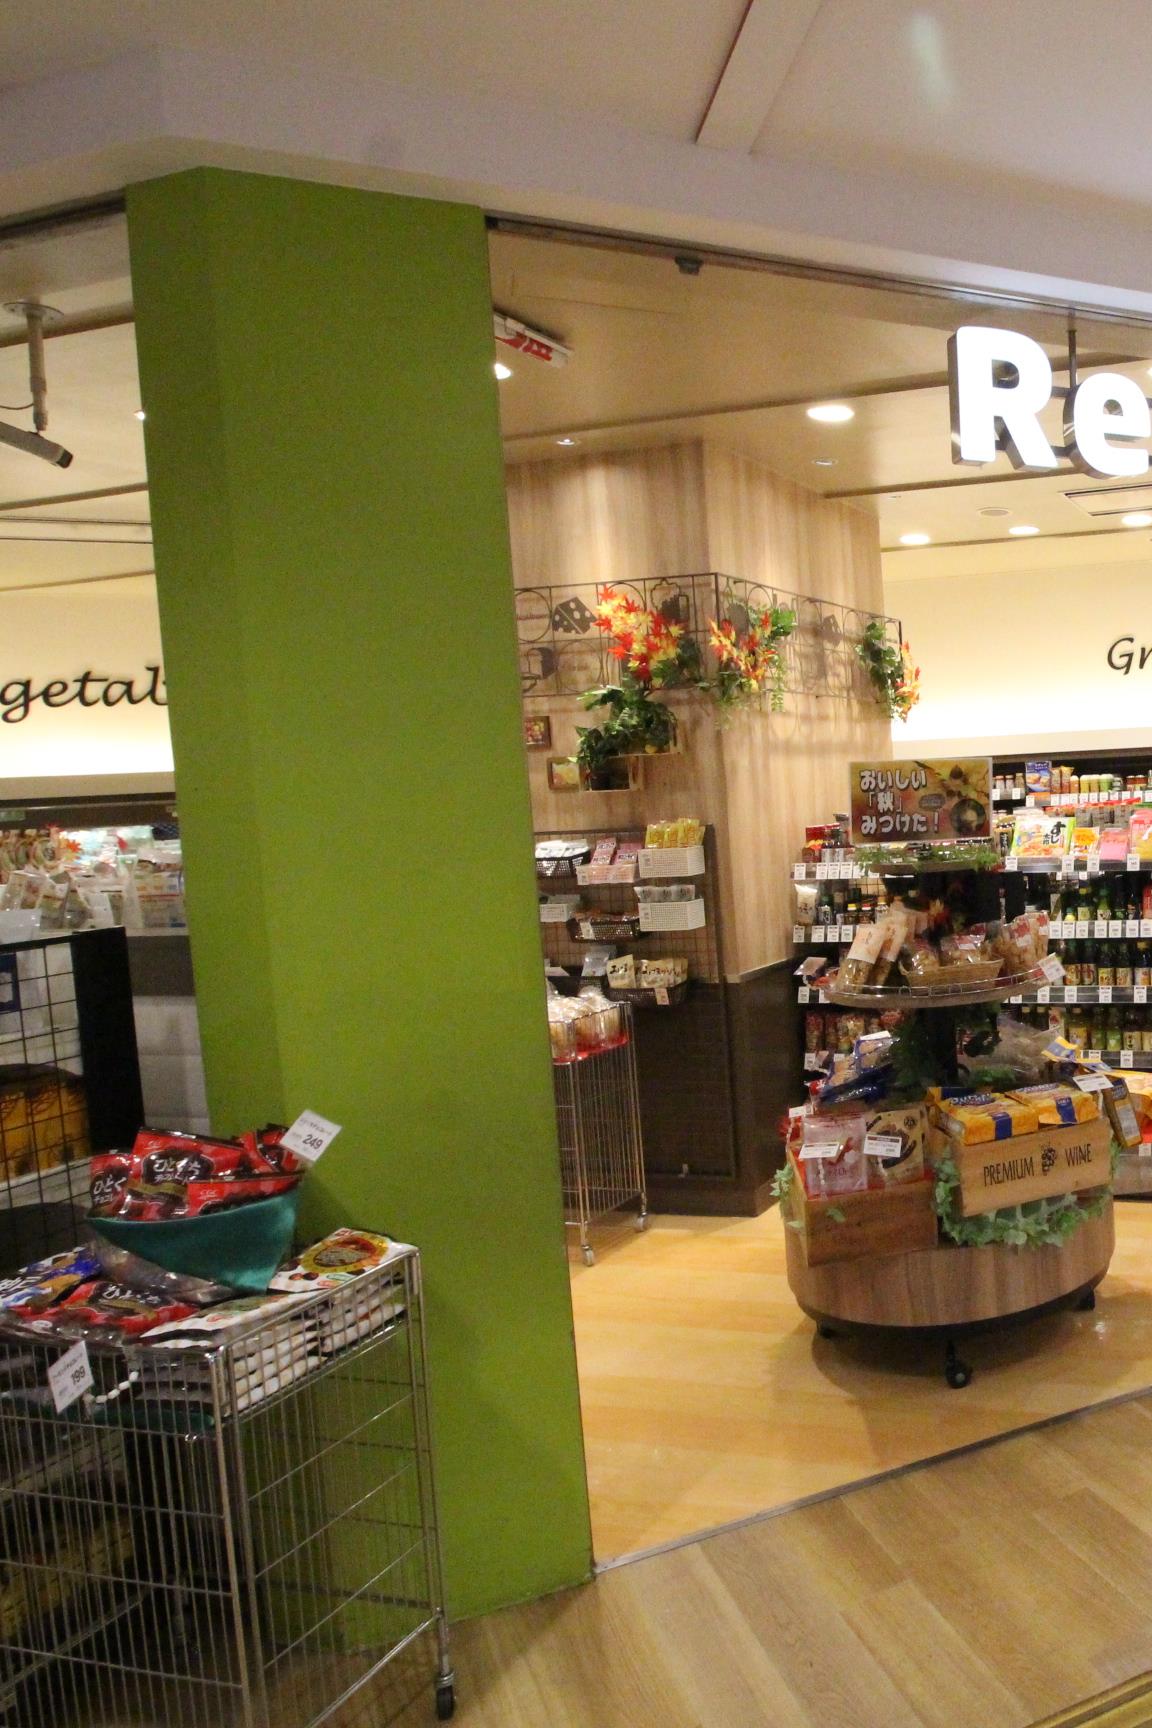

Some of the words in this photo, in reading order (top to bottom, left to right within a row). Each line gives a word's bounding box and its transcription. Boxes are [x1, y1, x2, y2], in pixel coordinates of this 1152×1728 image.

[860, 769, 927, 791] おいしい
[302, 1134, 324, 1150] 249
[983, 1157, 1035, 1187] PREMIUM
[1065, 1143, 1093, 1168] WINE
[71, 1365, 87, 1385] 199
